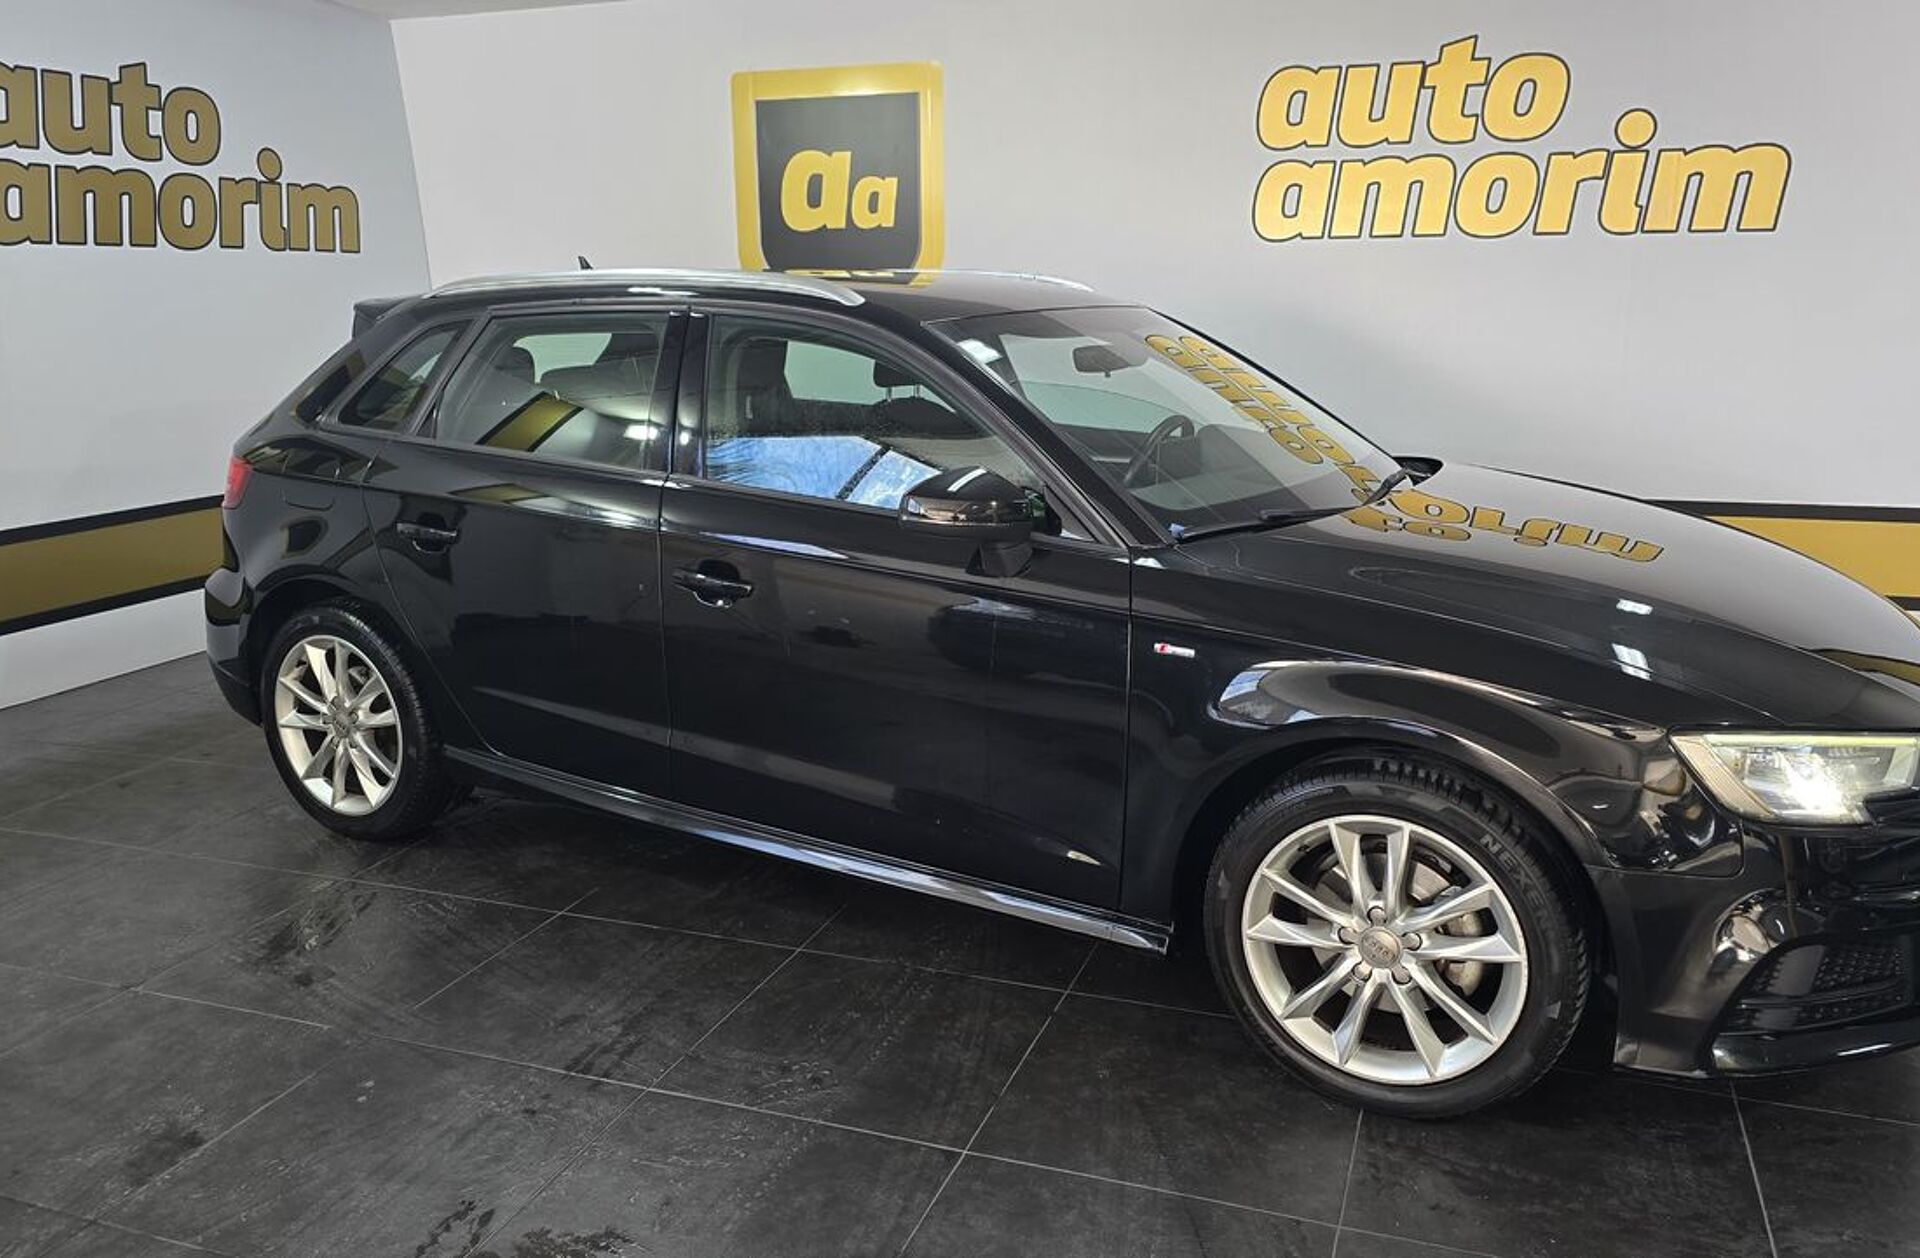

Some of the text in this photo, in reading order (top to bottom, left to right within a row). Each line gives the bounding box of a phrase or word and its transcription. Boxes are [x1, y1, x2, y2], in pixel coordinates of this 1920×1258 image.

[1257, 35, 1570, 150] auto
[0, 147, 361, 254] amorim
[780, 149, 898, 232] aa
[1252, 108, 1791, 242] amorim
